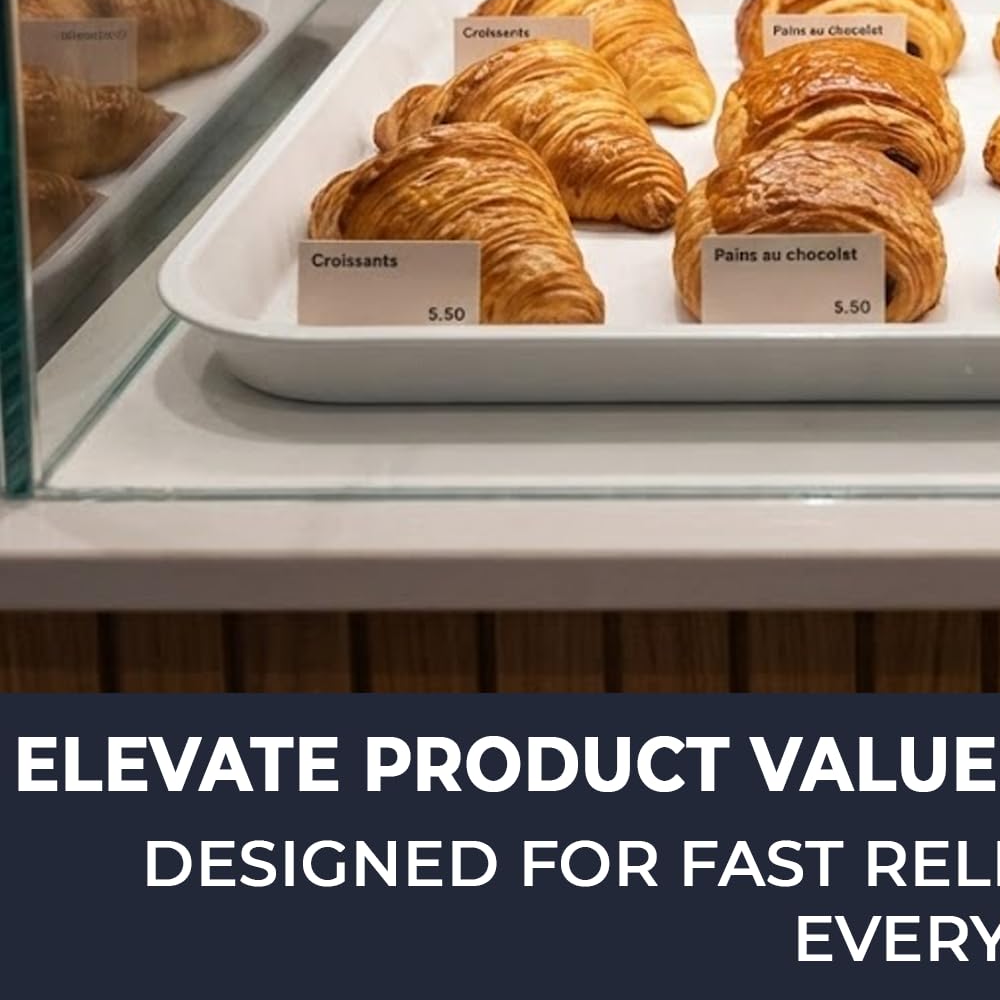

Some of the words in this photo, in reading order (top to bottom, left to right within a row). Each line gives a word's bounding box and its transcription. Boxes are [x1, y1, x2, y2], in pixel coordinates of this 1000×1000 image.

[311, 253, 398, 268] Croissants
[714, 248, 757, 262] Pains
[762, 251, 781, 262] au
[428, 306, 466, 321] 5.50
[834, 300, 871, 314] 5.50
